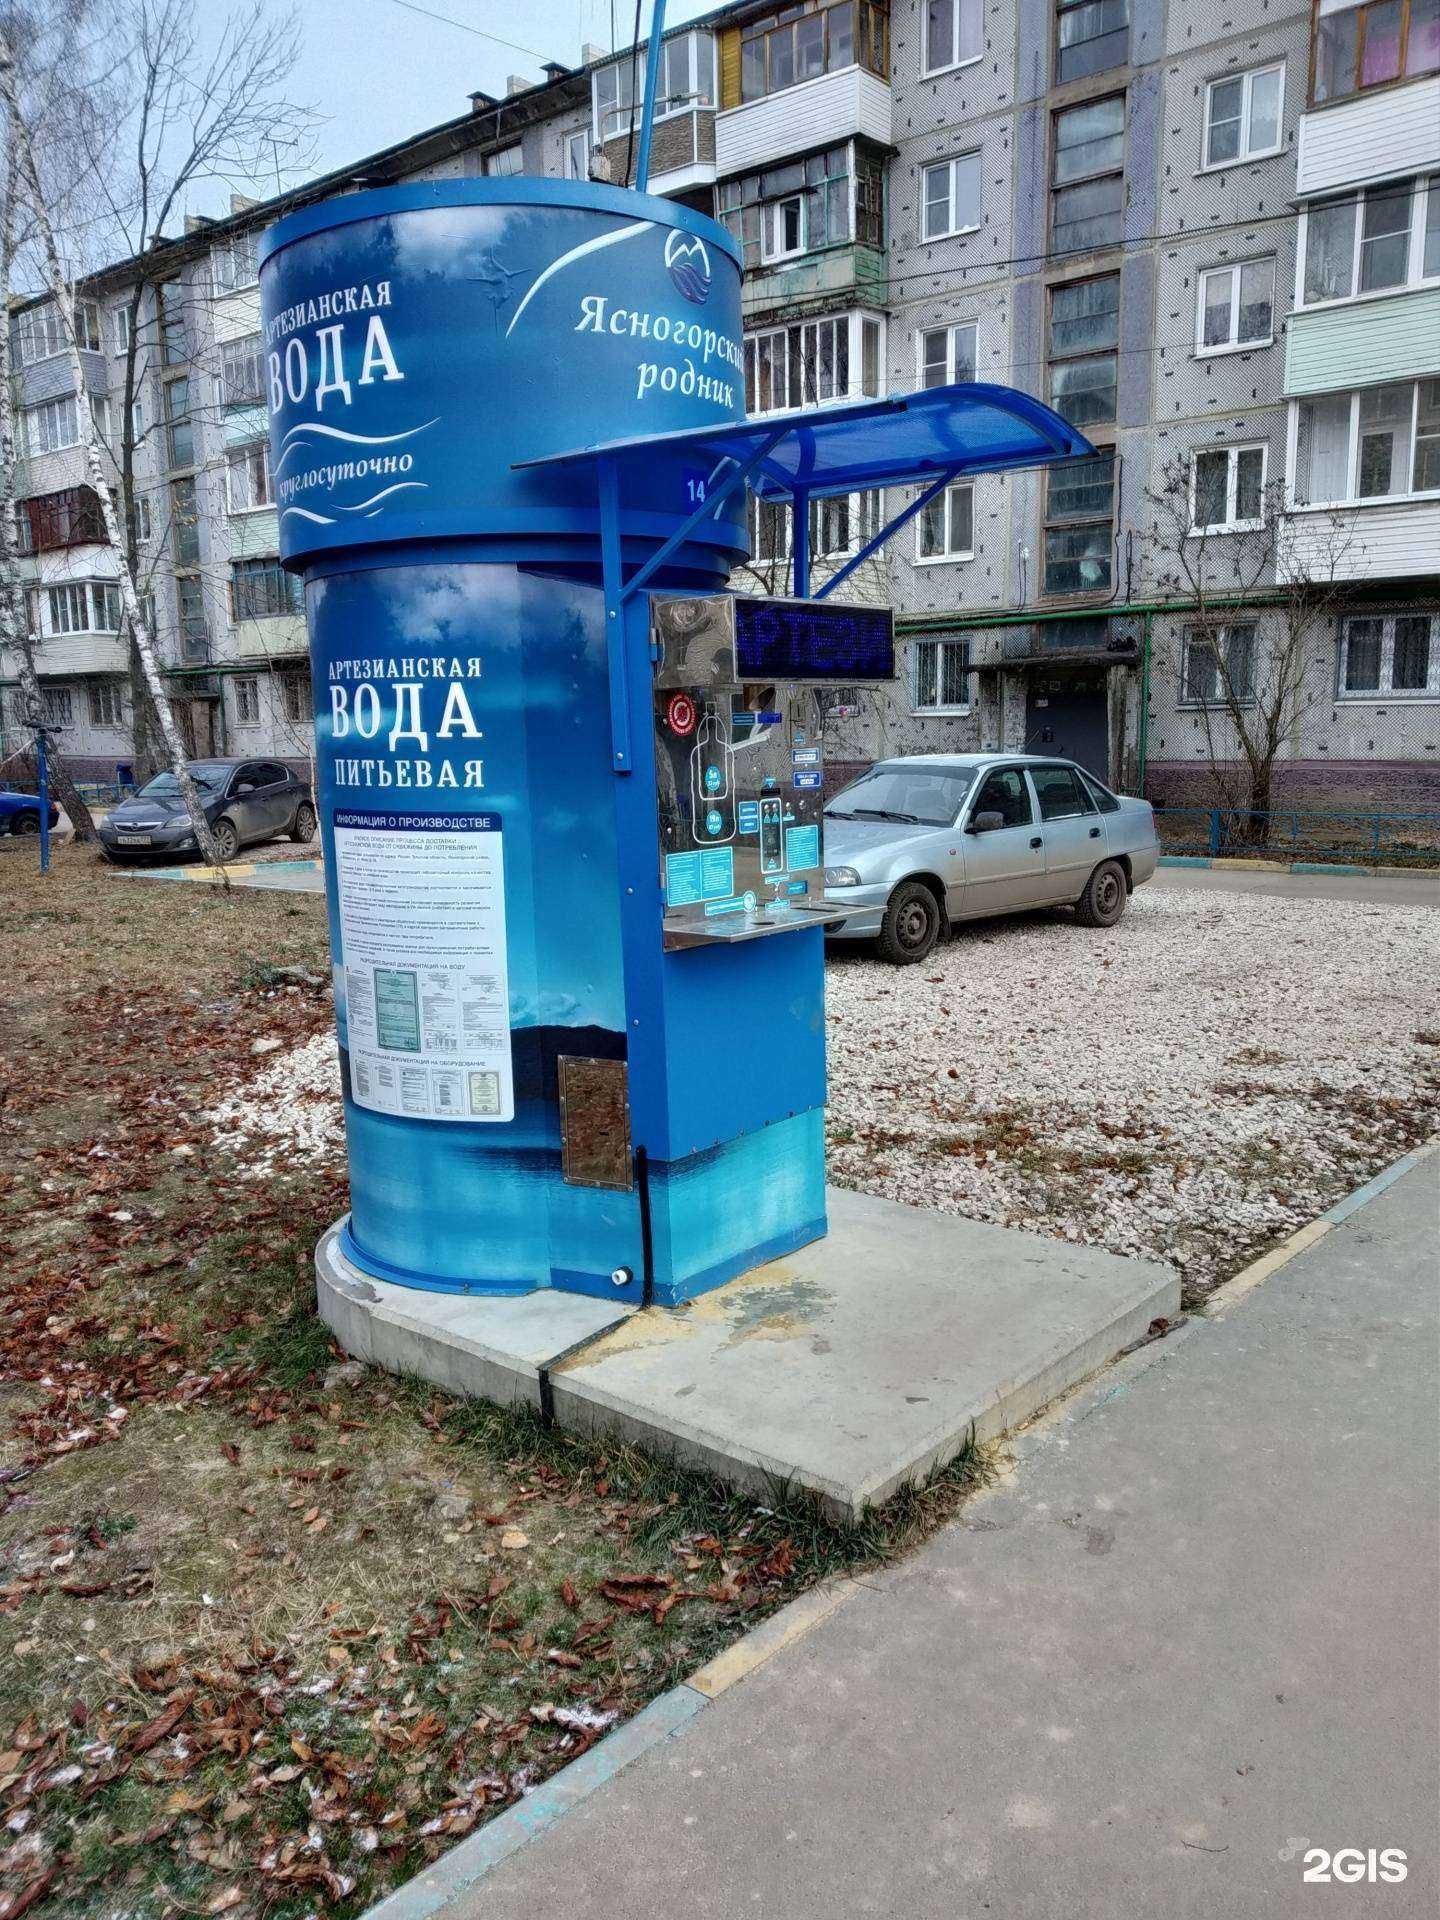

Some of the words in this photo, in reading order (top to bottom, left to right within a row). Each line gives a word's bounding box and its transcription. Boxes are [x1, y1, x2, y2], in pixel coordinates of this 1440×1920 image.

[265, 281, 392, 346] АРТЕЗИАНСКАЯ
[268, 314, 405, 415] ВОДА
[636, 358, 734, 408] родник
[279, 453, 413, 503] круглосуточно
[329, 657, 482, 680] АРТЕЗИАНСКАЯ
[329, 682, 483, 752] ВОДА
[334, 758, 485, 788] ПИТЬЕВАЯ
[336, 813, 386, 828] ИНФОРМАЦИЯ
[388, 816, 397, 827] О
[398, 816, 491, 830] ПРОИЗВОДСТВЕ
